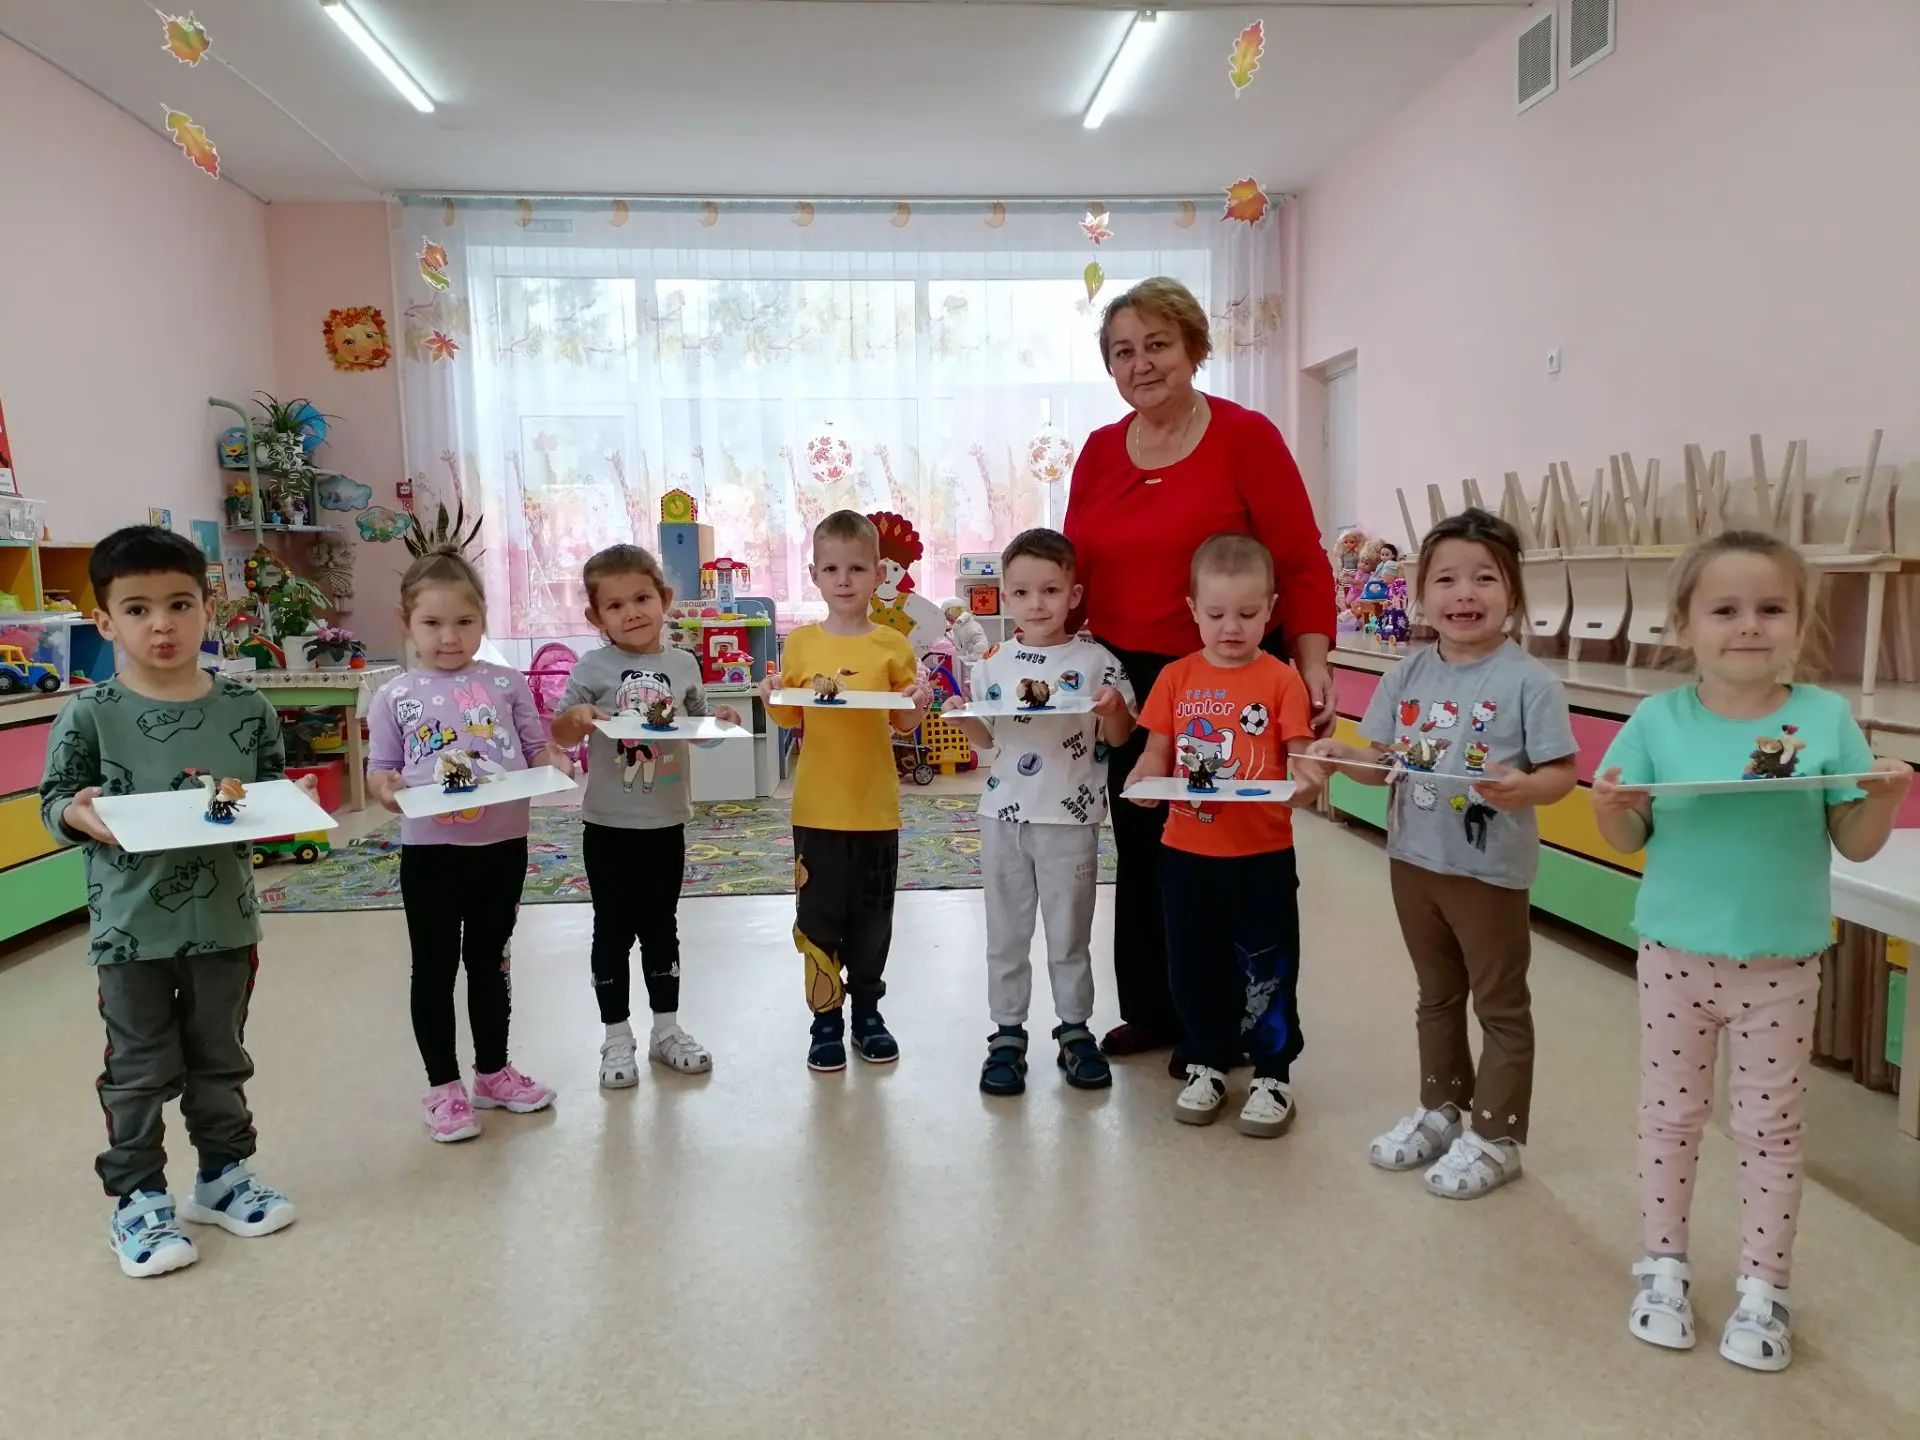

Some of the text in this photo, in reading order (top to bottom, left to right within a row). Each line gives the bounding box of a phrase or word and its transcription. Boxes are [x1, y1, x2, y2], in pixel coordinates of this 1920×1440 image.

[1185, 689, 1226, 701] TEAM
[1063, 731, 1084, 749] READY
[1071, 742, 1082, 753] TO
